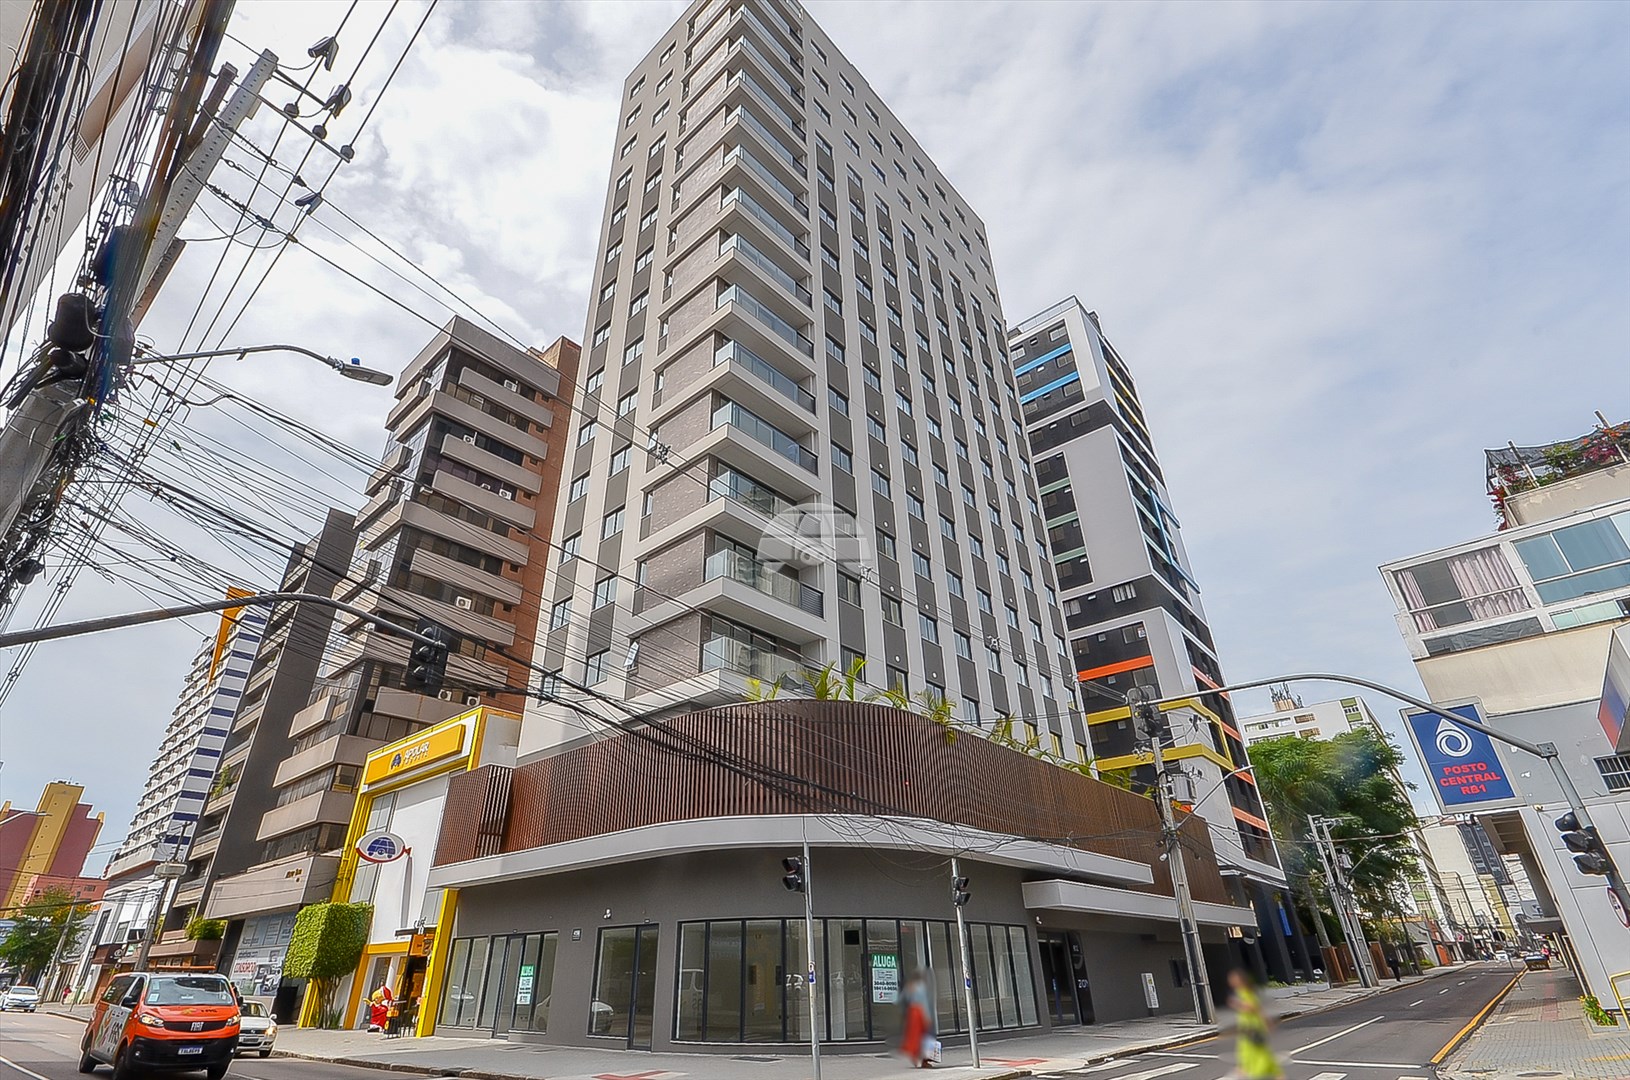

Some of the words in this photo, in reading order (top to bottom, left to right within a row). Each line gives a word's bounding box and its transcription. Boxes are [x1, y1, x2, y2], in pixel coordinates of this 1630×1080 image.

[1443, 762, 1488, 776] POSTO
[1440, 771, 1501, 787] CENTRAL
[1460, 783, 1487, 795] RB1
[873, 955, 897, 968] ALUGA
[190, 1021, 204, 1031] FIAT
